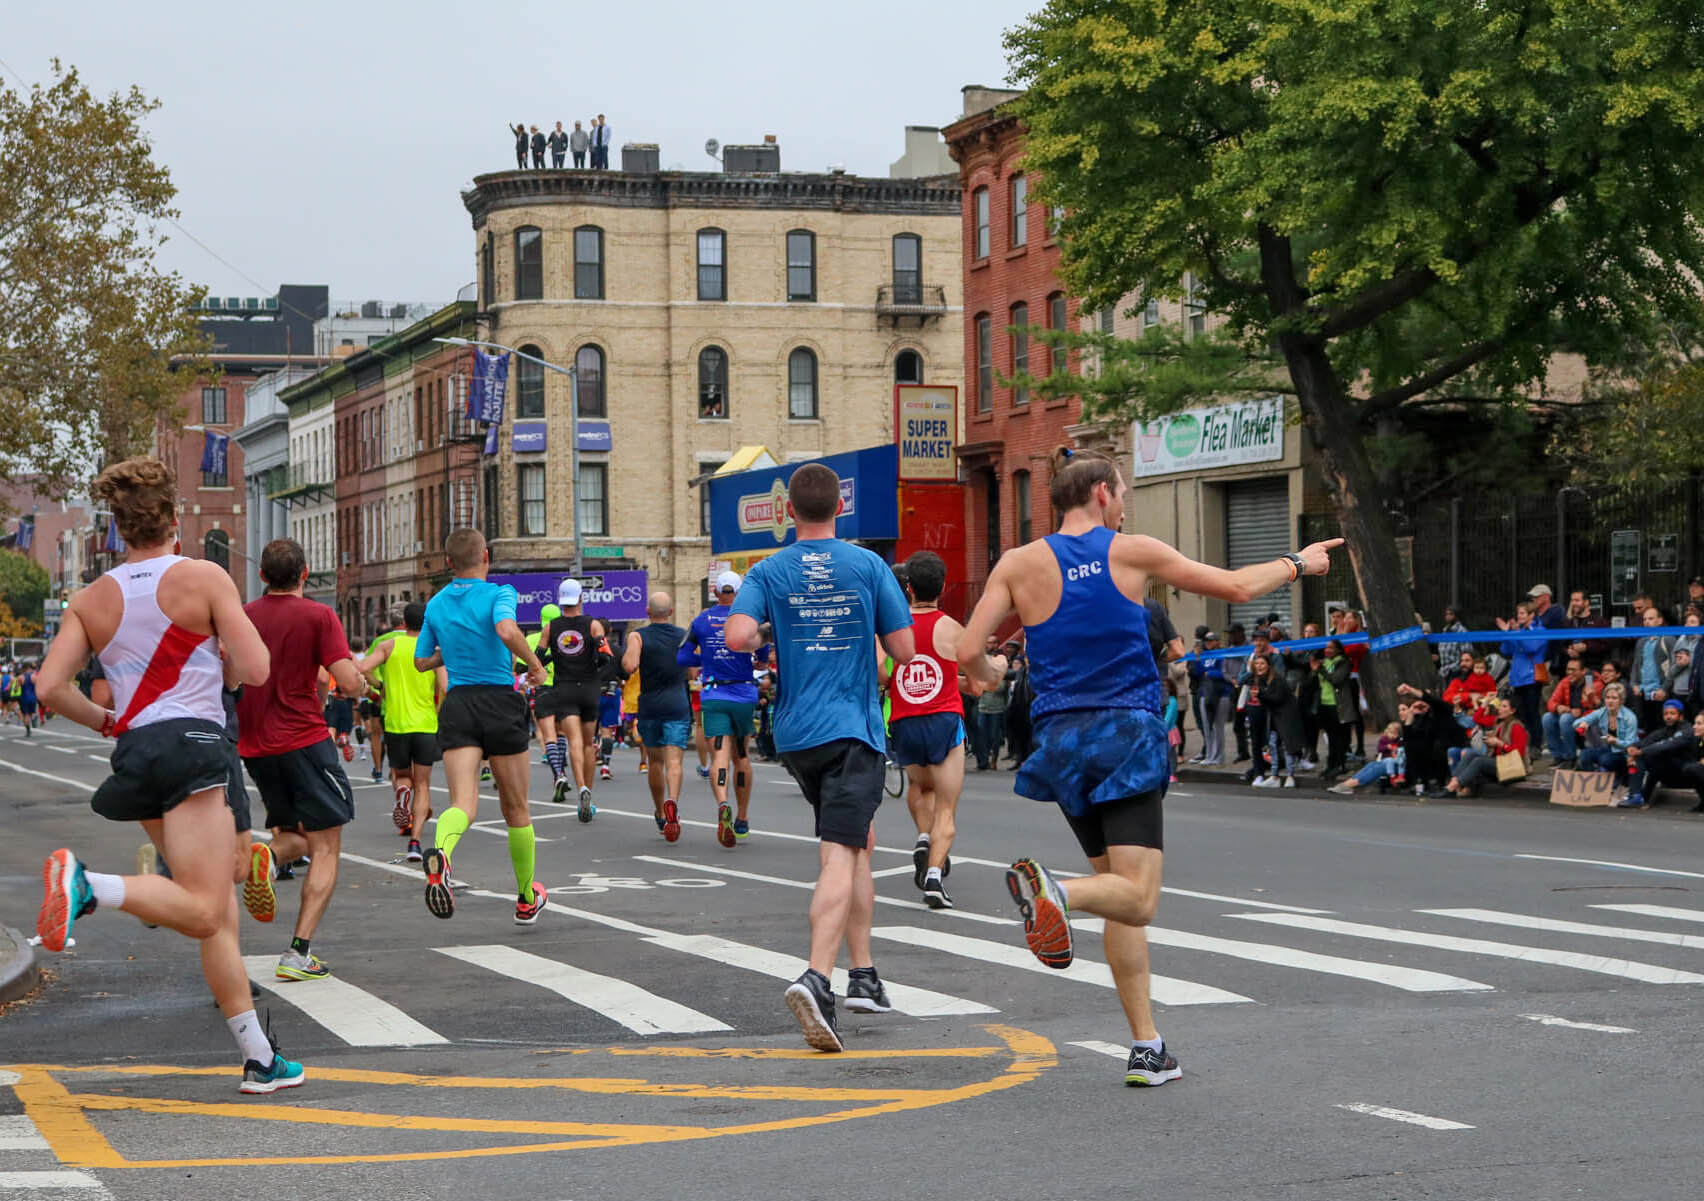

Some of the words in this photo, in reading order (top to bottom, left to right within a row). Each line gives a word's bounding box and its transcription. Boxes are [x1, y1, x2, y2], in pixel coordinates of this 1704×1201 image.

[491, 381, 505, 421] ROUTE
[908, 419, 947, 437] SUPER
[1201, 414, 1227, 453] Flea
[1230, 406, 1277, 449] Market
[903, 440, 952, 458] MARKET
[1067, 560, 1102, 581] CRC
[517, 590, 552, 604] troPCS
[582, 586, 642, 603] etroPCS
[1556, 772, 1611, 793] NYU
